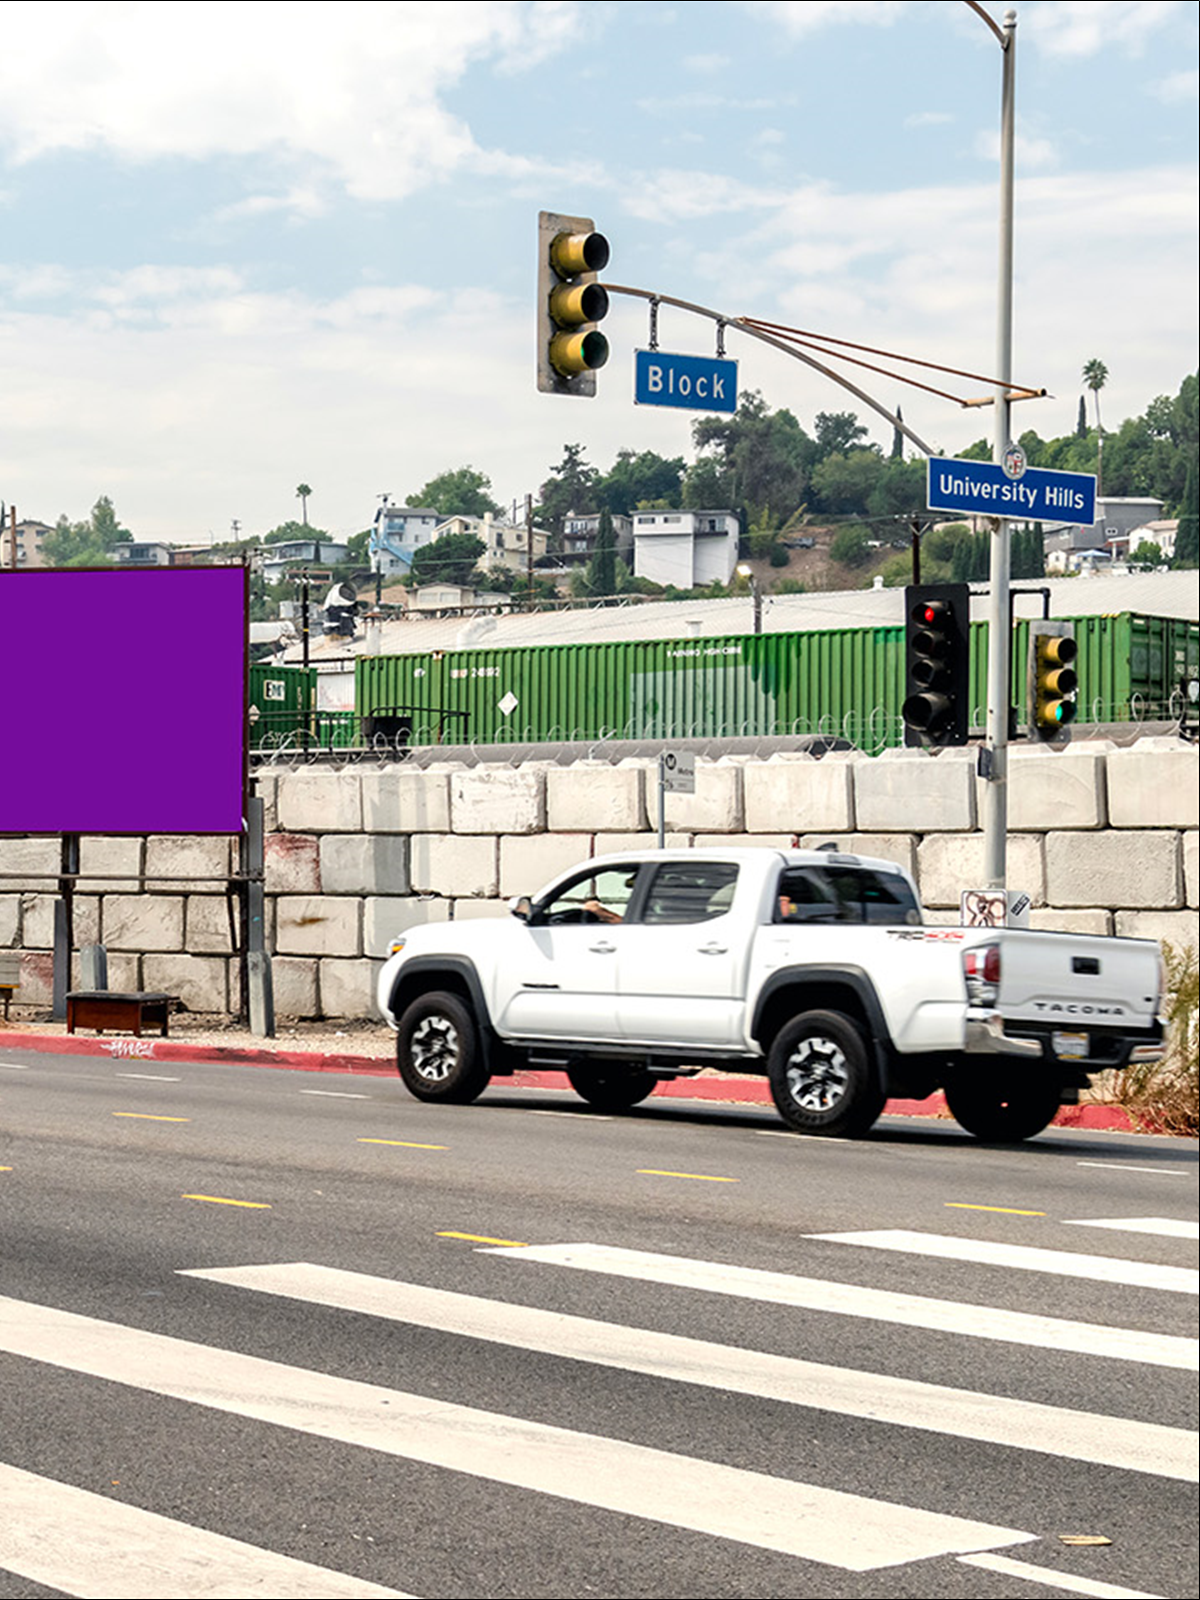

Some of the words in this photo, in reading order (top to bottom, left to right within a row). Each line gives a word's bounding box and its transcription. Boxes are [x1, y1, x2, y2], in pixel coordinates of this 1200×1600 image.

[648, 365, 725, 399] Block
[940, 474, 1037, 509] University
[1045, 486, 1084, 509] Hills
[1033, 1002, 1125, 1016] TACOMA
